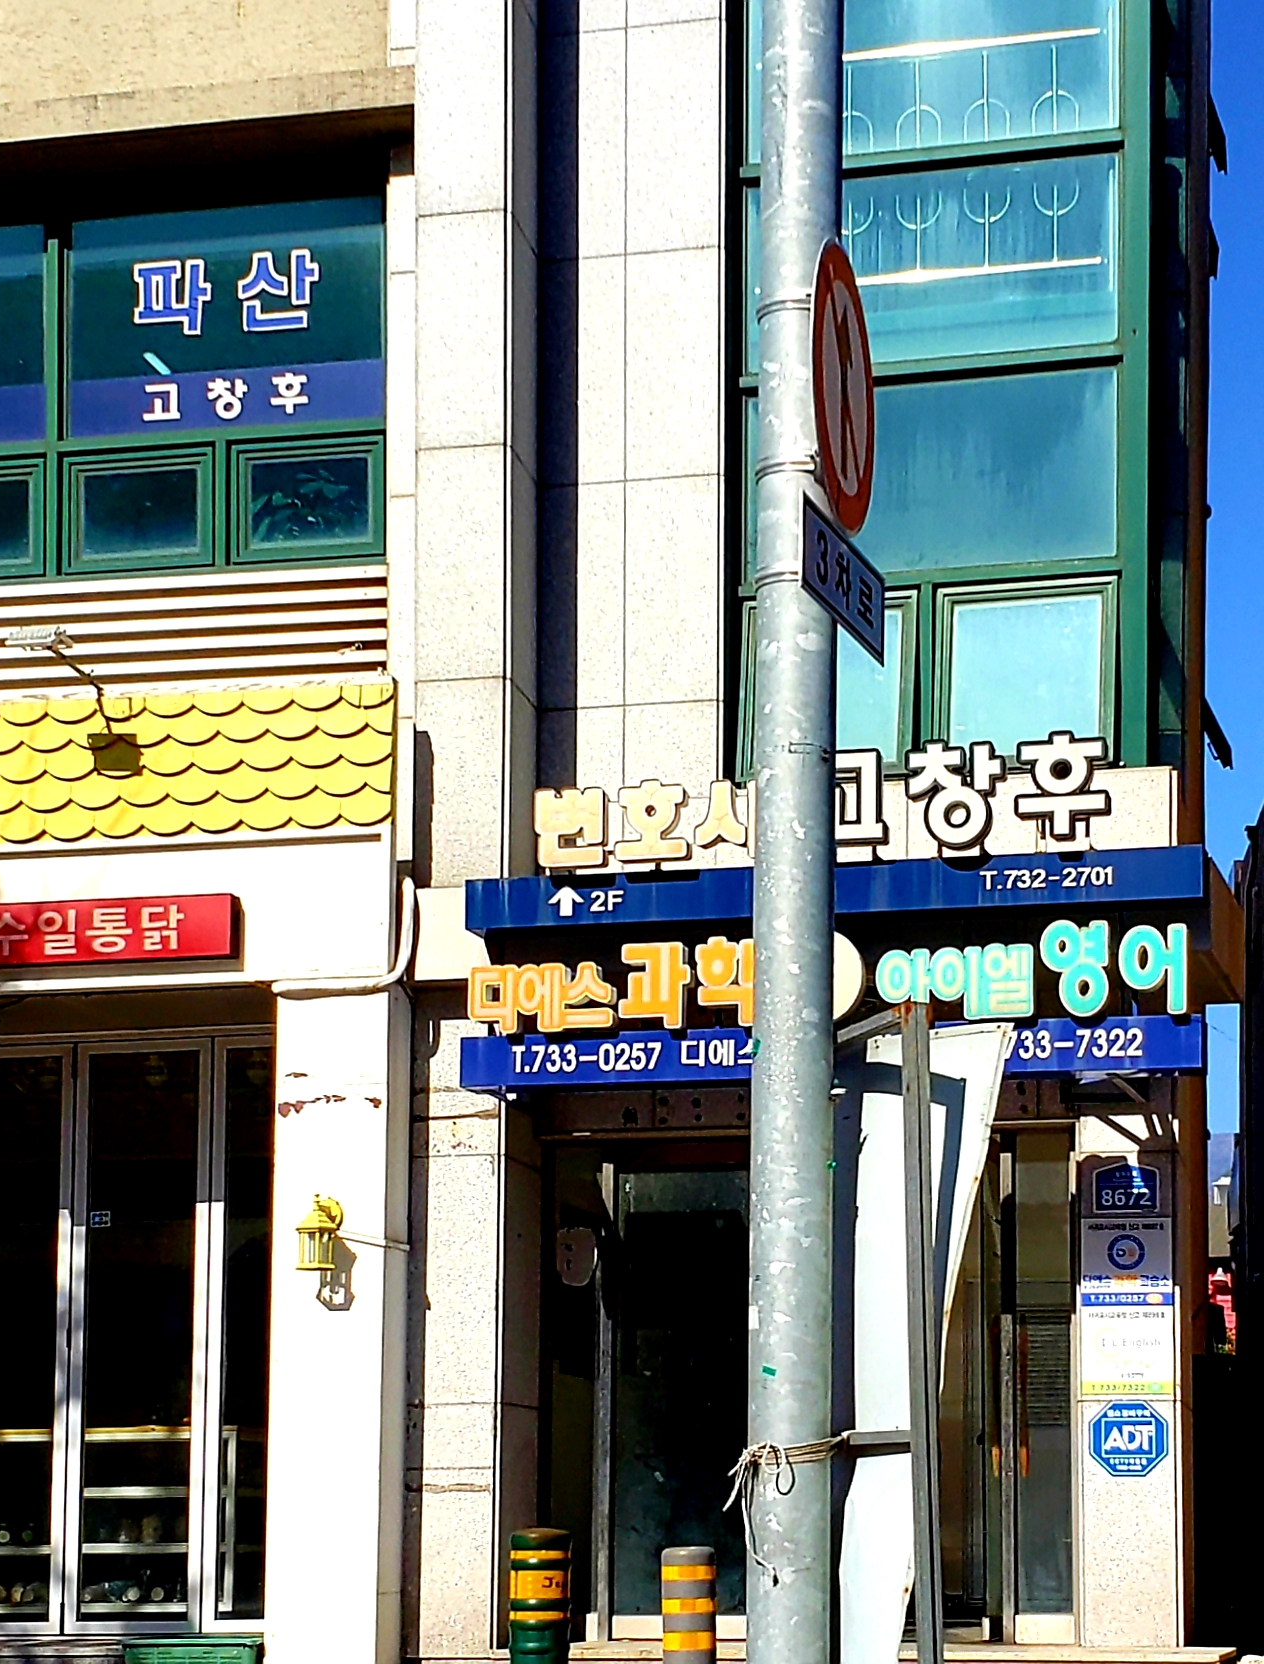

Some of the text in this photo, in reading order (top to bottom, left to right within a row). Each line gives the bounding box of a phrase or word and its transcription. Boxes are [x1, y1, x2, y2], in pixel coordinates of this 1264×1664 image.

[133, 249, 319, 334] 파산
[142, 372, 309, 422] 고창후
[979, 866, 1114, 891] T.732-2701
[590, 890, 624, 912] 2F
[876, 920, 1188, 1020] 아이엘 영어
[511, 1041, 661, 1074] T.733-0257
[1102, 1189, 1152, 1206] 8672
[1104, 1424, 1153, 1451] ADT
